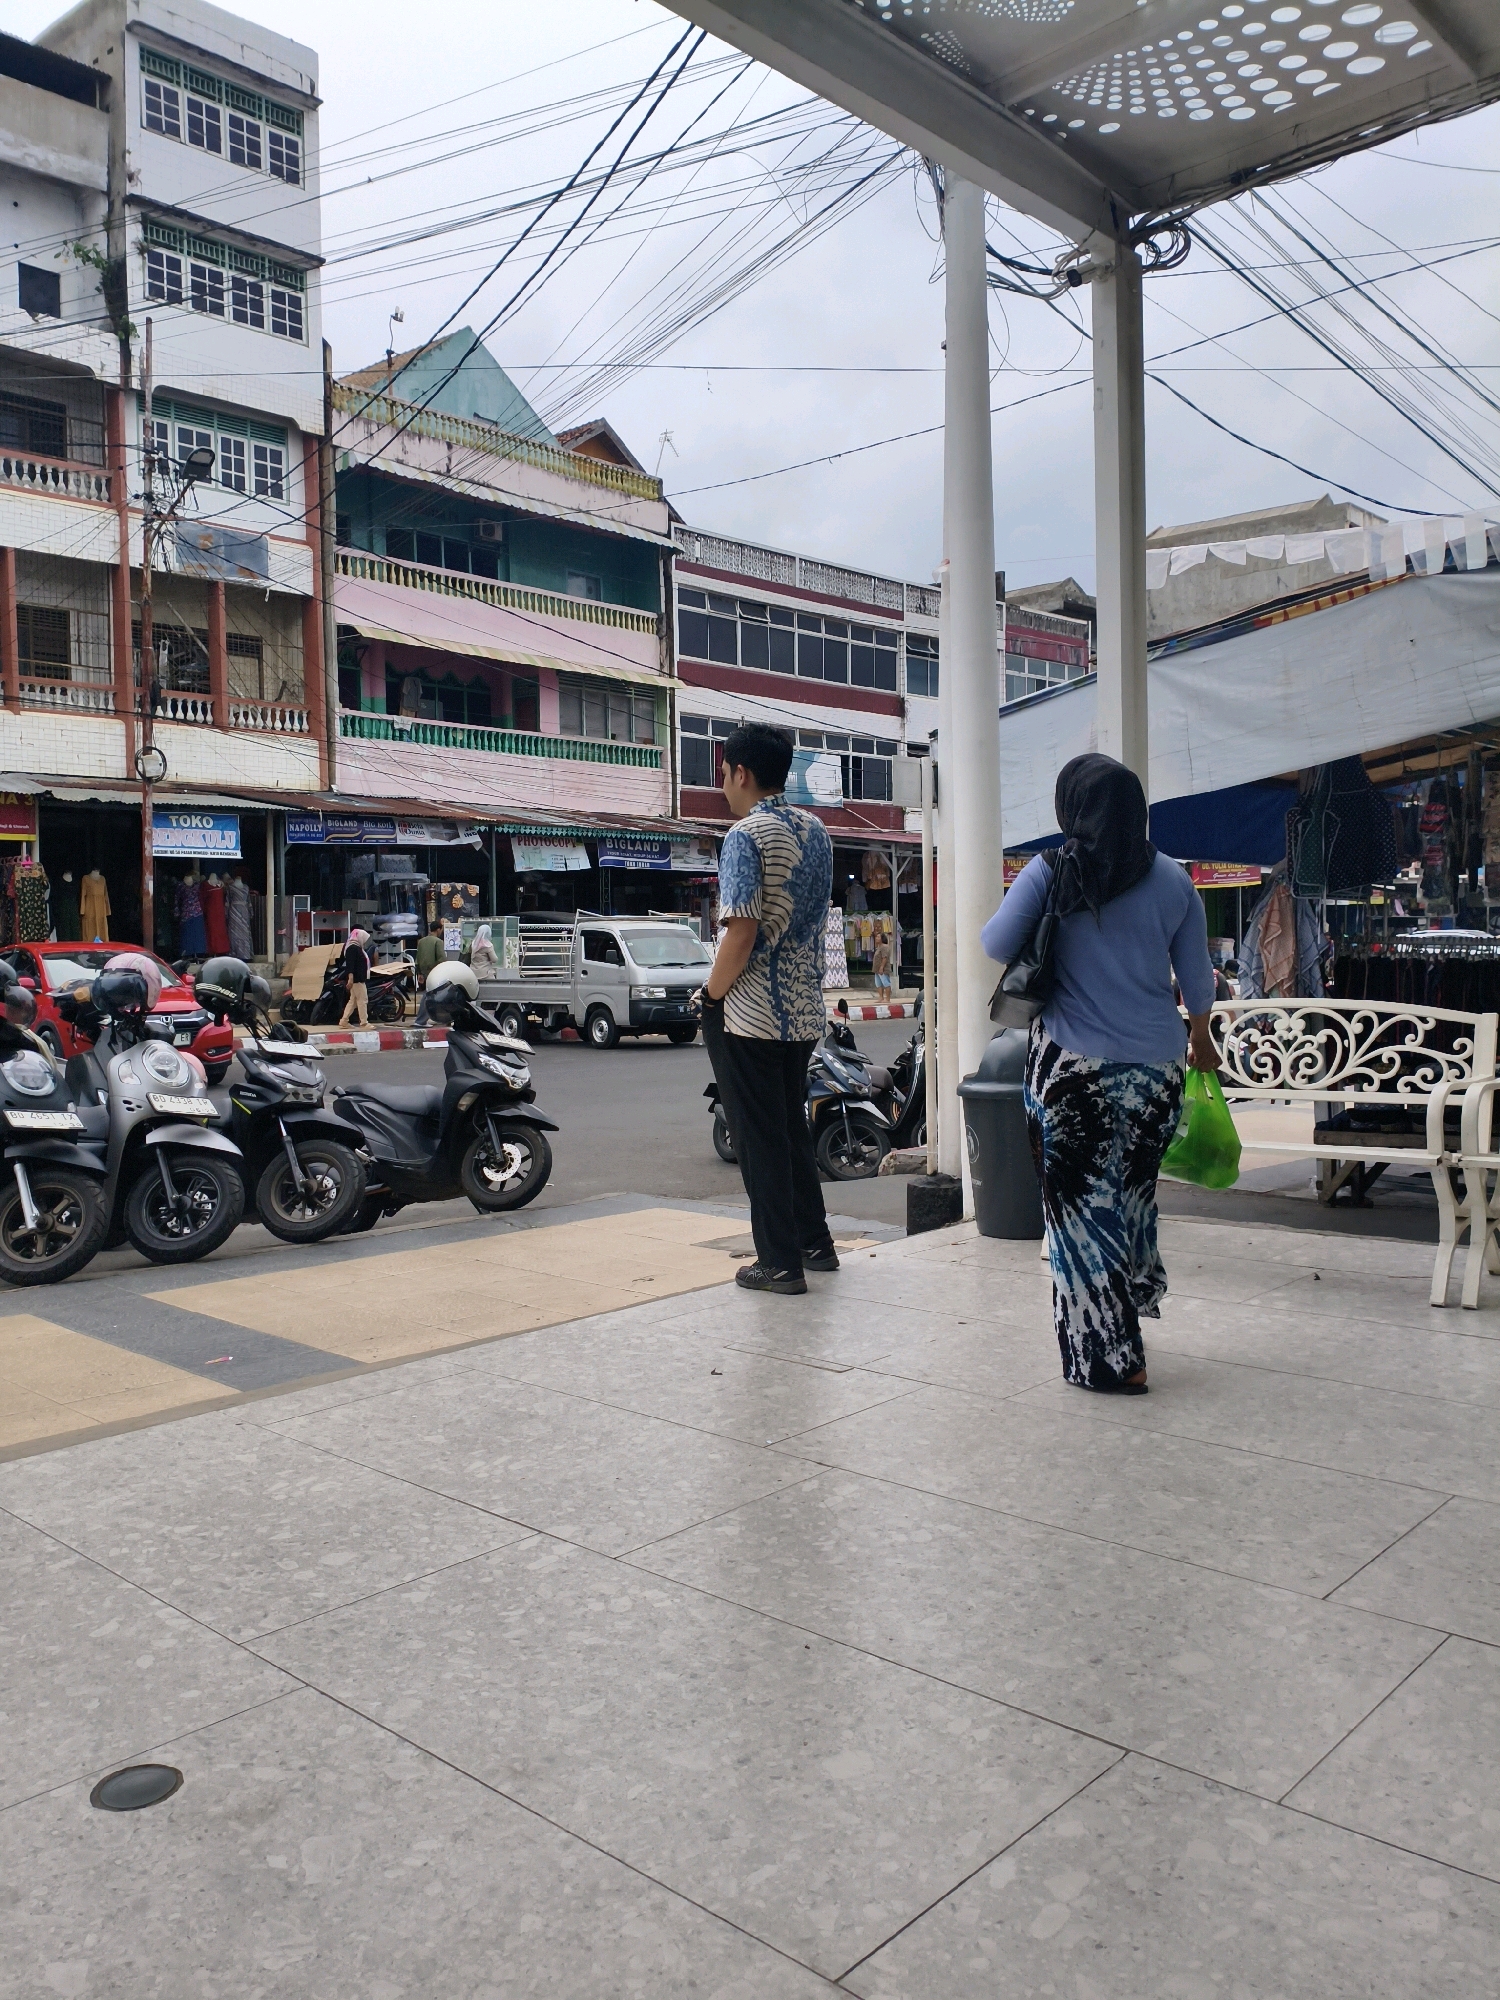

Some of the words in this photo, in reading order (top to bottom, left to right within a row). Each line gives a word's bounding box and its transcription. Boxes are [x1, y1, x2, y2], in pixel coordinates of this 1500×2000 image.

[168, 815, 214, 829] TOKO
[289, 823, 323, 832] NAPOLLY
[363, 820, 376, 828] BIG
[517, 835, 577, 848] PHOTOCOPY
[605, 838, 660, 852] BIGLAND
[1211, 862, 1227, 870] YULIA
